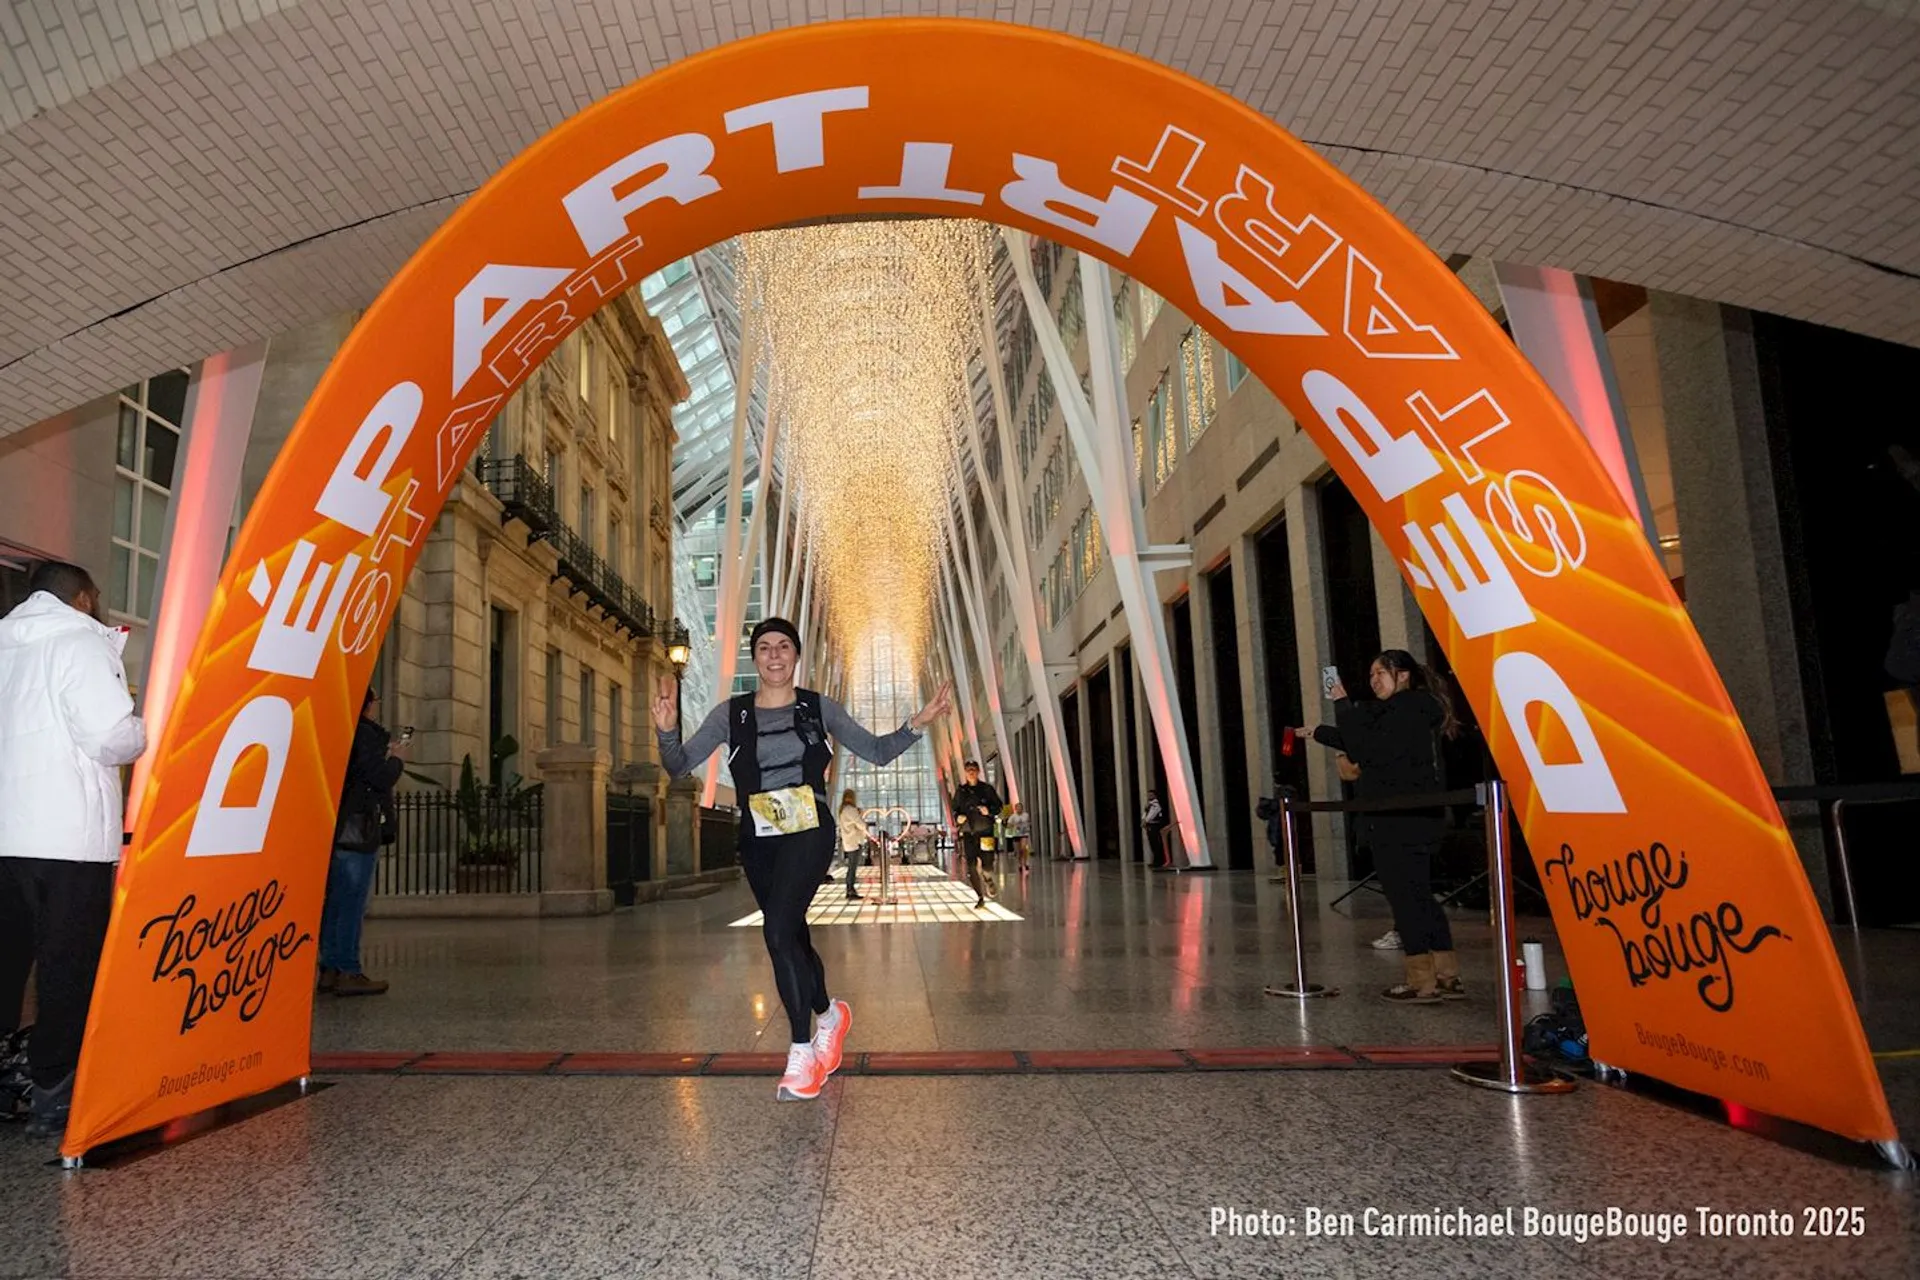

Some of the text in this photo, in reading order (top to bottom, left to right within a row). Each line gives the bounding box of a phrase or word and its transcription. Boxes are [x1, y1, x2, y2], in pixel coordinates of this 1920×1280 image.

[1110, 123, 1588, 578] START
[184, 85, 869, 858] DÉPART
[337, 235, 643, 657] START
[858, 141, 1627, 814] DÉPART
[139, 879, 287, 982] bouge
[1545, 842, 1688, 930] bouge
[171, 921, 313, 1035] bouge
[1594, 902, 1792, 1012] bouge
[157, 1050, 263, 1098] BougeBouge.com
[1634, 1022, 1771, 1081] BougeBouge.com
